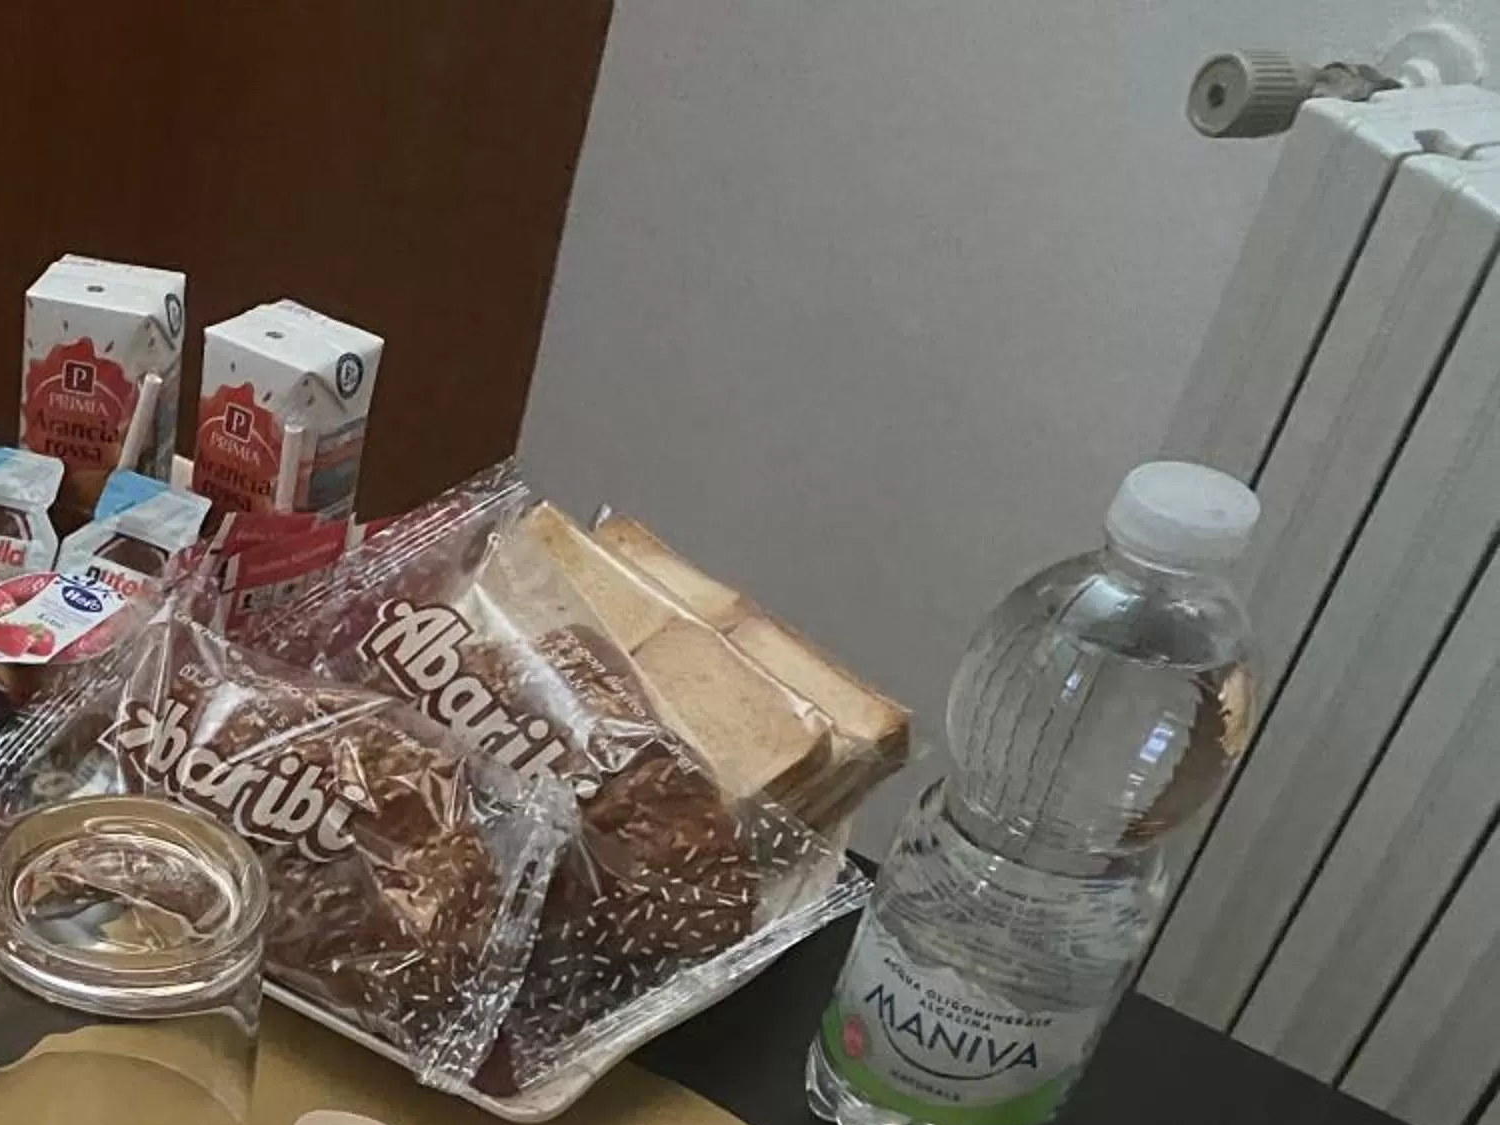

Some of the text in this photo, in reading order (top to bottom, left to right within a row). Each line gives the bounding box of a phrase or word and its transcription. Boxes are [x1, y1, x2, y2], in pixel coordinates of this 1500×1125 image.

[72, 367, 87, 389] P
[31, 407, 120, 444] Arancia
[232, 410, 246, 433] P
[44, 437, 102, 462] rossa
[63, 587, 102, 612] Hero
[864, 983, 1038, 1071] MANIVA
